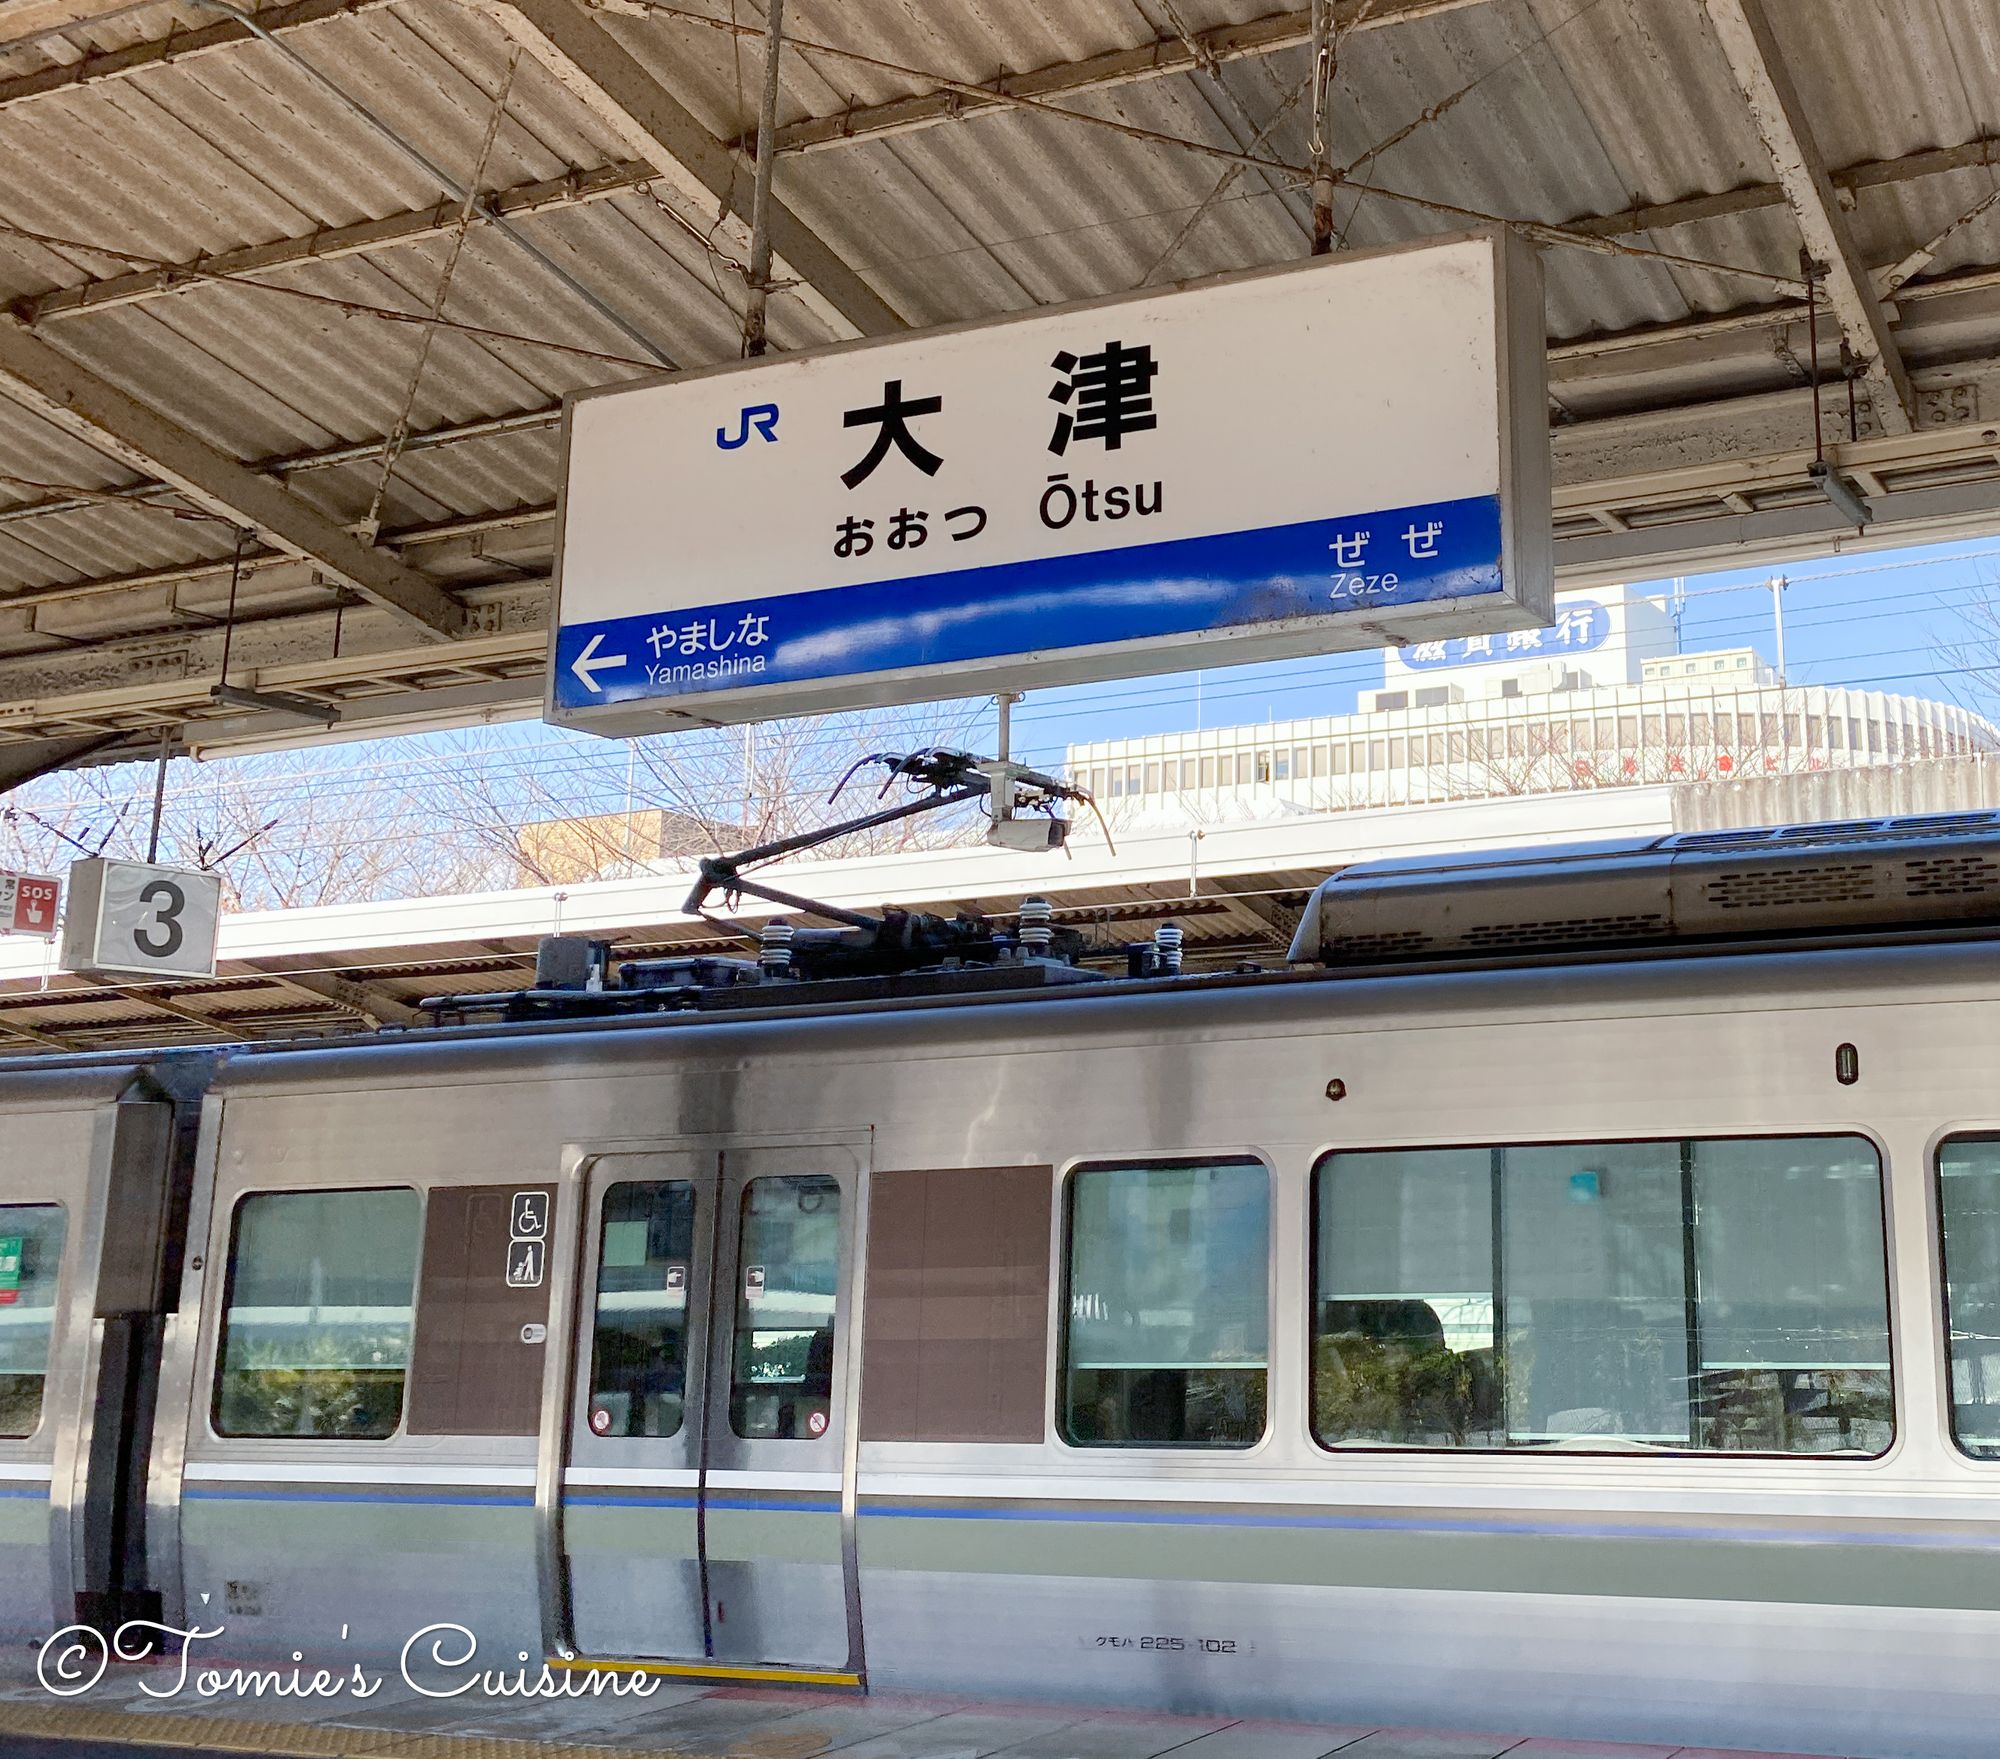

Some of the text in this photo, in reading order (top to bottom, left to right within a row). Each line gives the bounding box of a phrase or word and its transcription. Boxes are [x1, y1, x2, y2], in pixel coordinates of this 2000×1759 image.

[716, 403, 780, 450] JR
[839, 339, 1160, 492] 大津
[1038, 472, 1164, 530] Ōtsu
[833, 505, 988, 559] おおつ
[1328, 520, 1444, 569] ぜぜ
[1329, 571, 1399, 600] Zeze
[645, 612, 770, 660] やましな
[644, 652, 766, 687] Yamashina
[21, 885, 53, 901] SOS
[133, 879, 186, 958] 3
